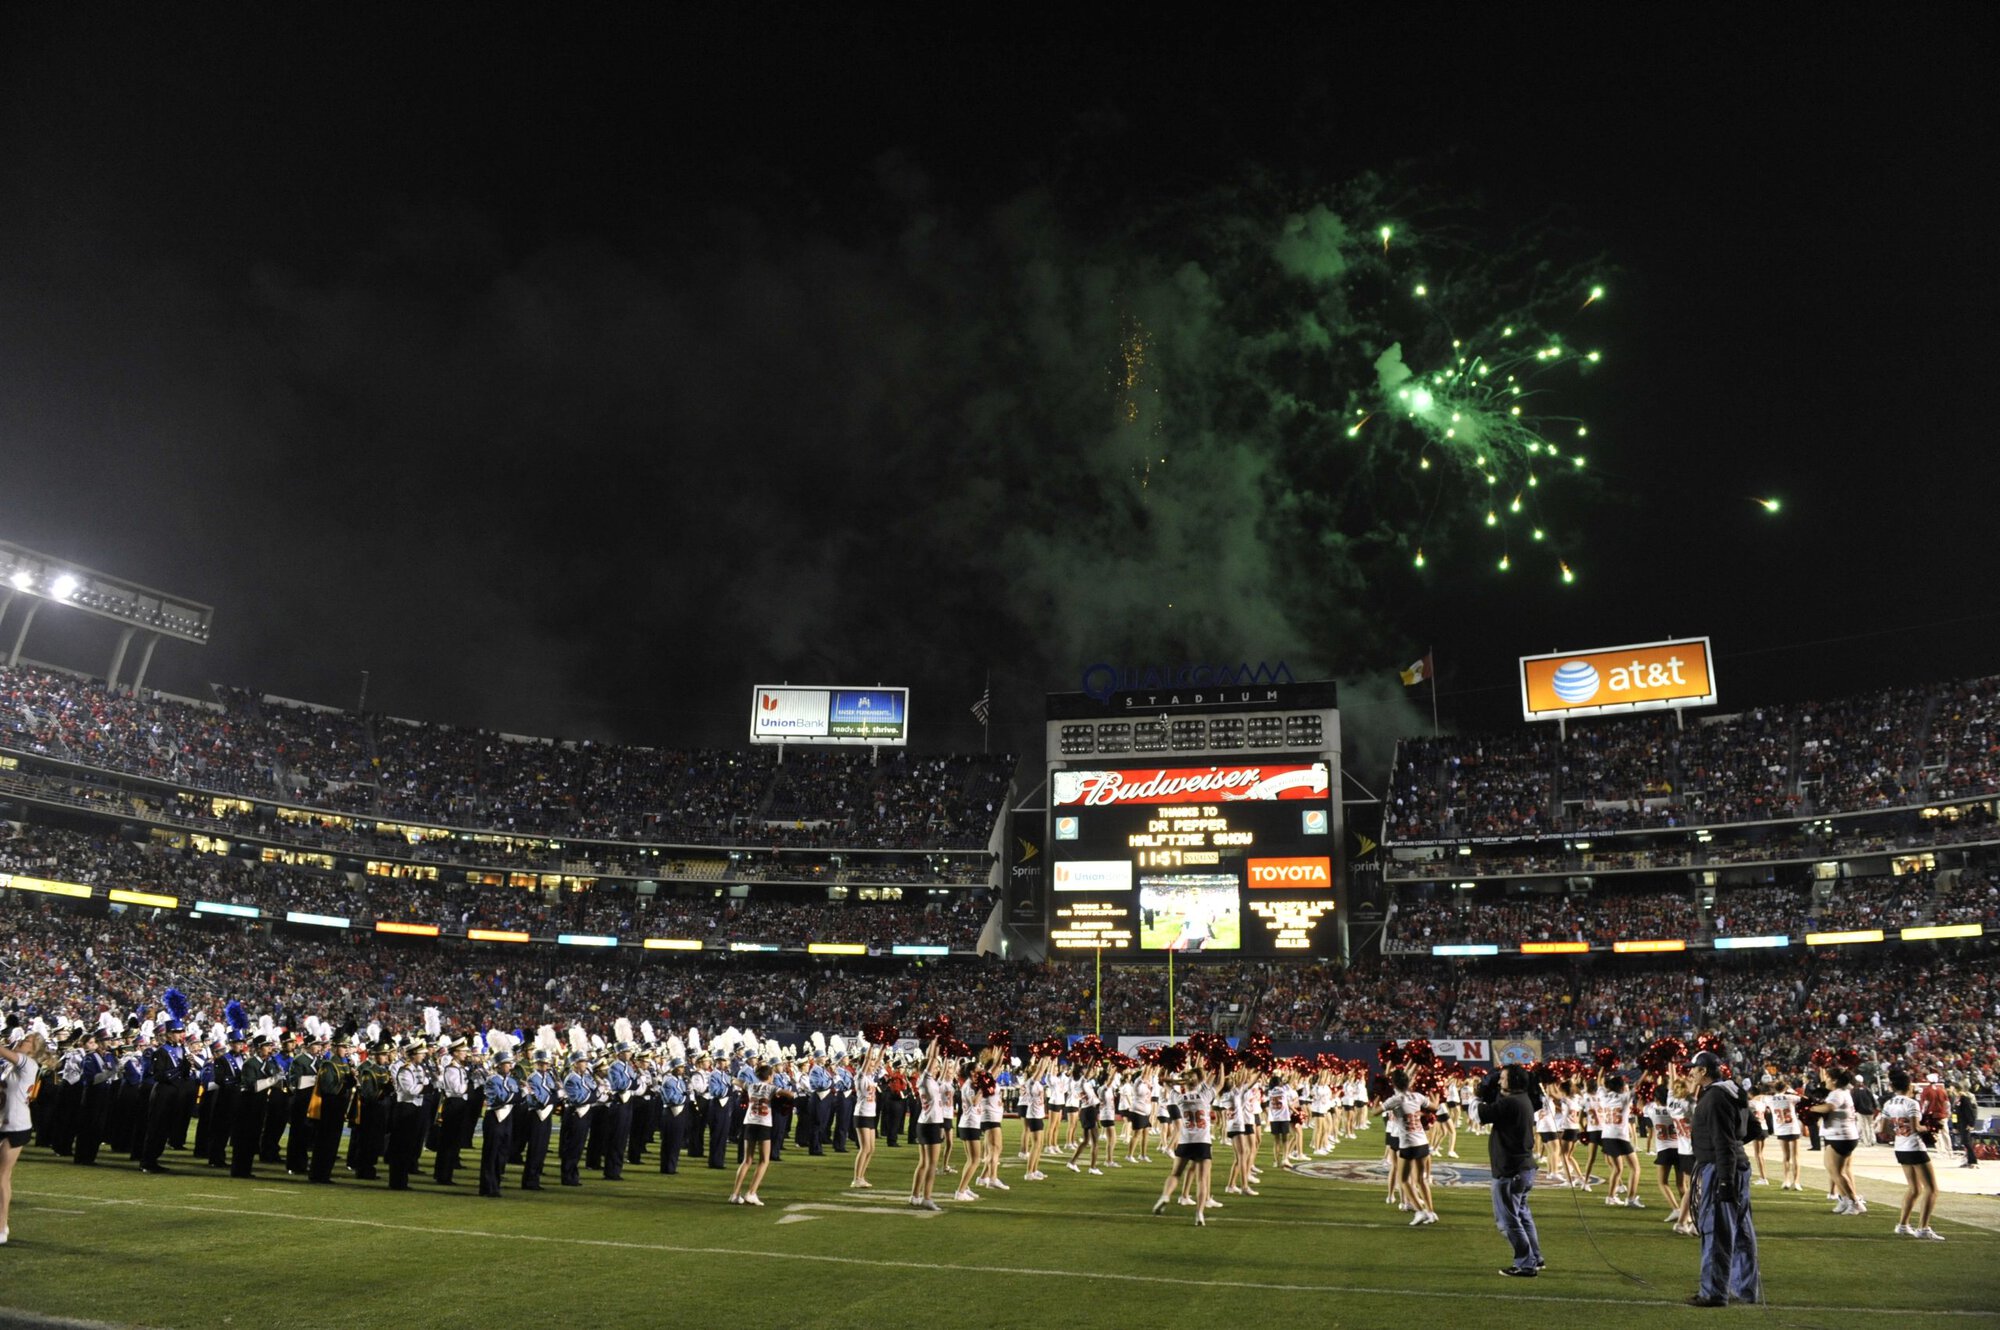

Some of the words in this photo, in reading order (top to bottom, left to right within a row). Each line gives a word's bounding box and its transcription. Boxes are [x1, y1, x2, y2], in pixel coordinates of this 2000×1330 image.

[1608, 655, 1686, 691] at&t
[1082, 660, 1295, 704] QUALCOMM
[1126, 691, 1277, 706] STADIUM
[761, 718, 824, 728] UnionBank
[1079, 767, 1260, 806] Budweiser
[1158, 807, 1199, 818] THANKS
[1202, 806, 1218, 817] TO
[1149, 820, 1169, 832] DR
[1174, 818, 1227, 831] PEPPER
[1129, 833, 1205, 847] HALFTIME
[1213, 832, 1253, 845] SHOW
[1012, 865, 1041, 877] Sprint
[1251, 865, 1327, 881] TOYOTA
[1348, 861, 1381, 872] Sprint
[1463, 1042, 1482, 1059] N
